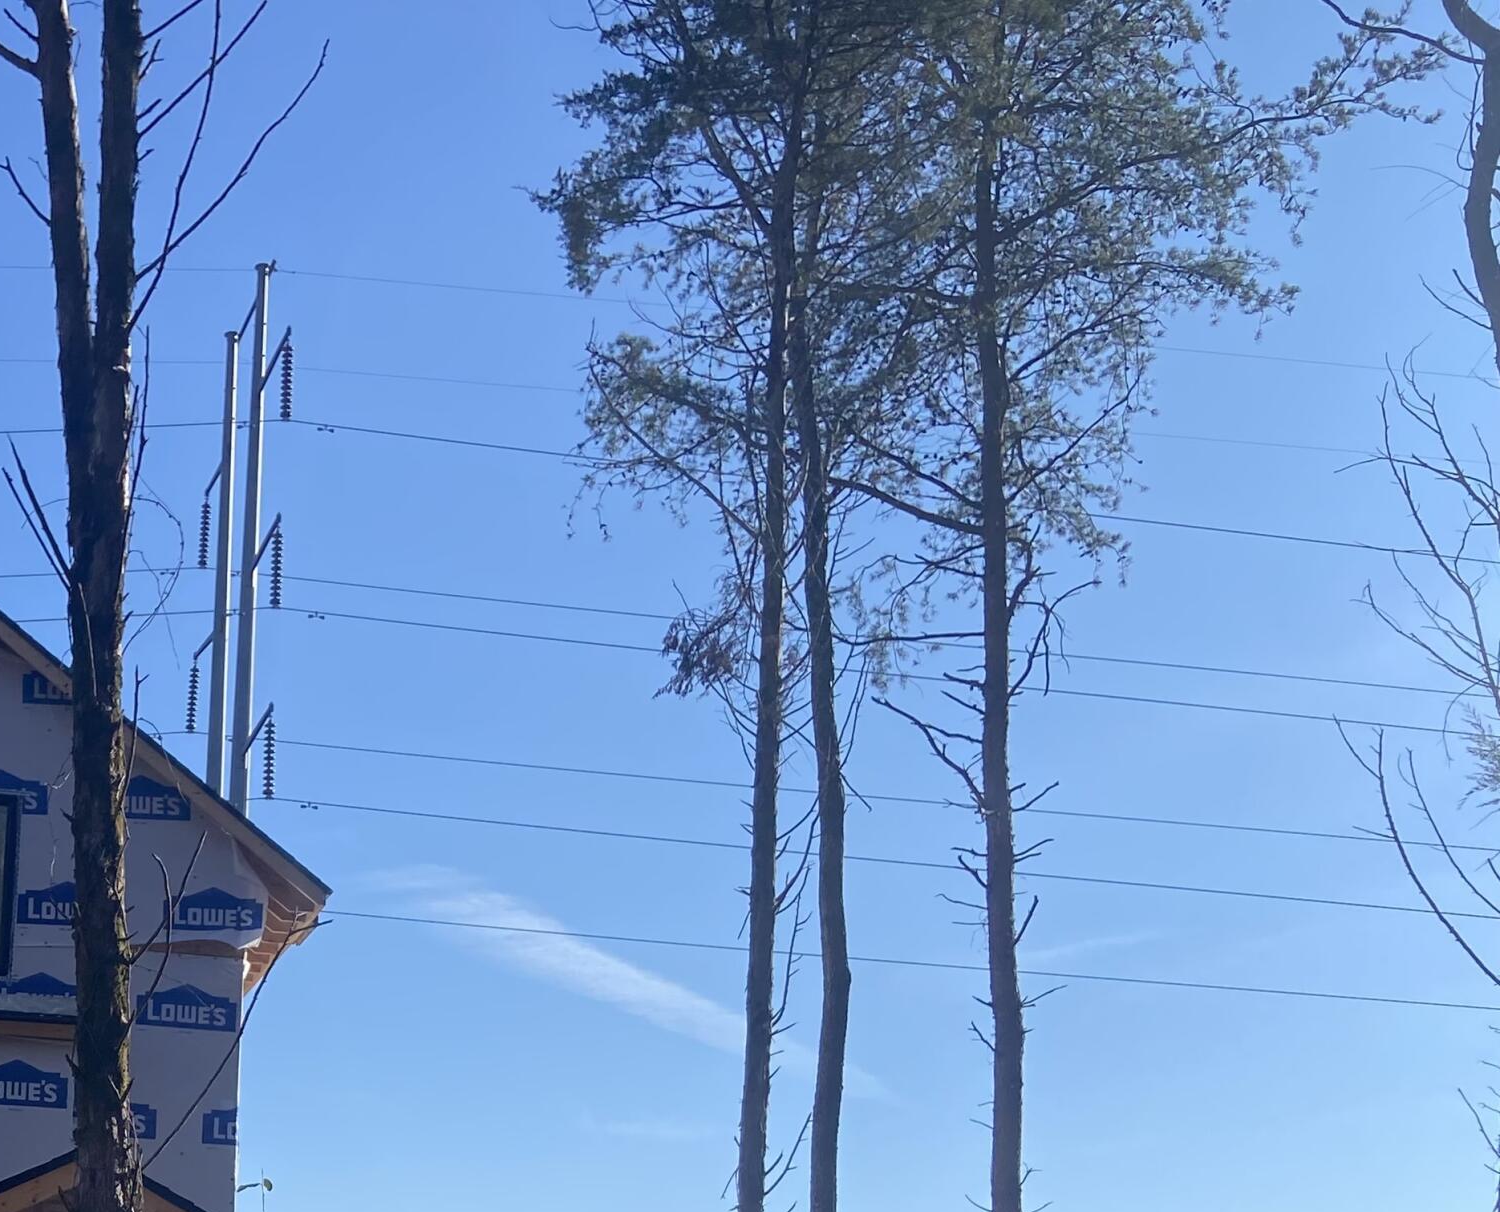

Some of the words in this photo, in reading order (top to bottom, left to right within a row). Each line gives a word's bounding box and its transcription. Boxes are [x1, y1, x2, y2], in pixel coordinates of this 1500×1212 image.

[125, 794, 181, 816] WE'S
[174, 904, 253, 928] LOWE'S
[147, 999, 227, 1027] LOWE'S
